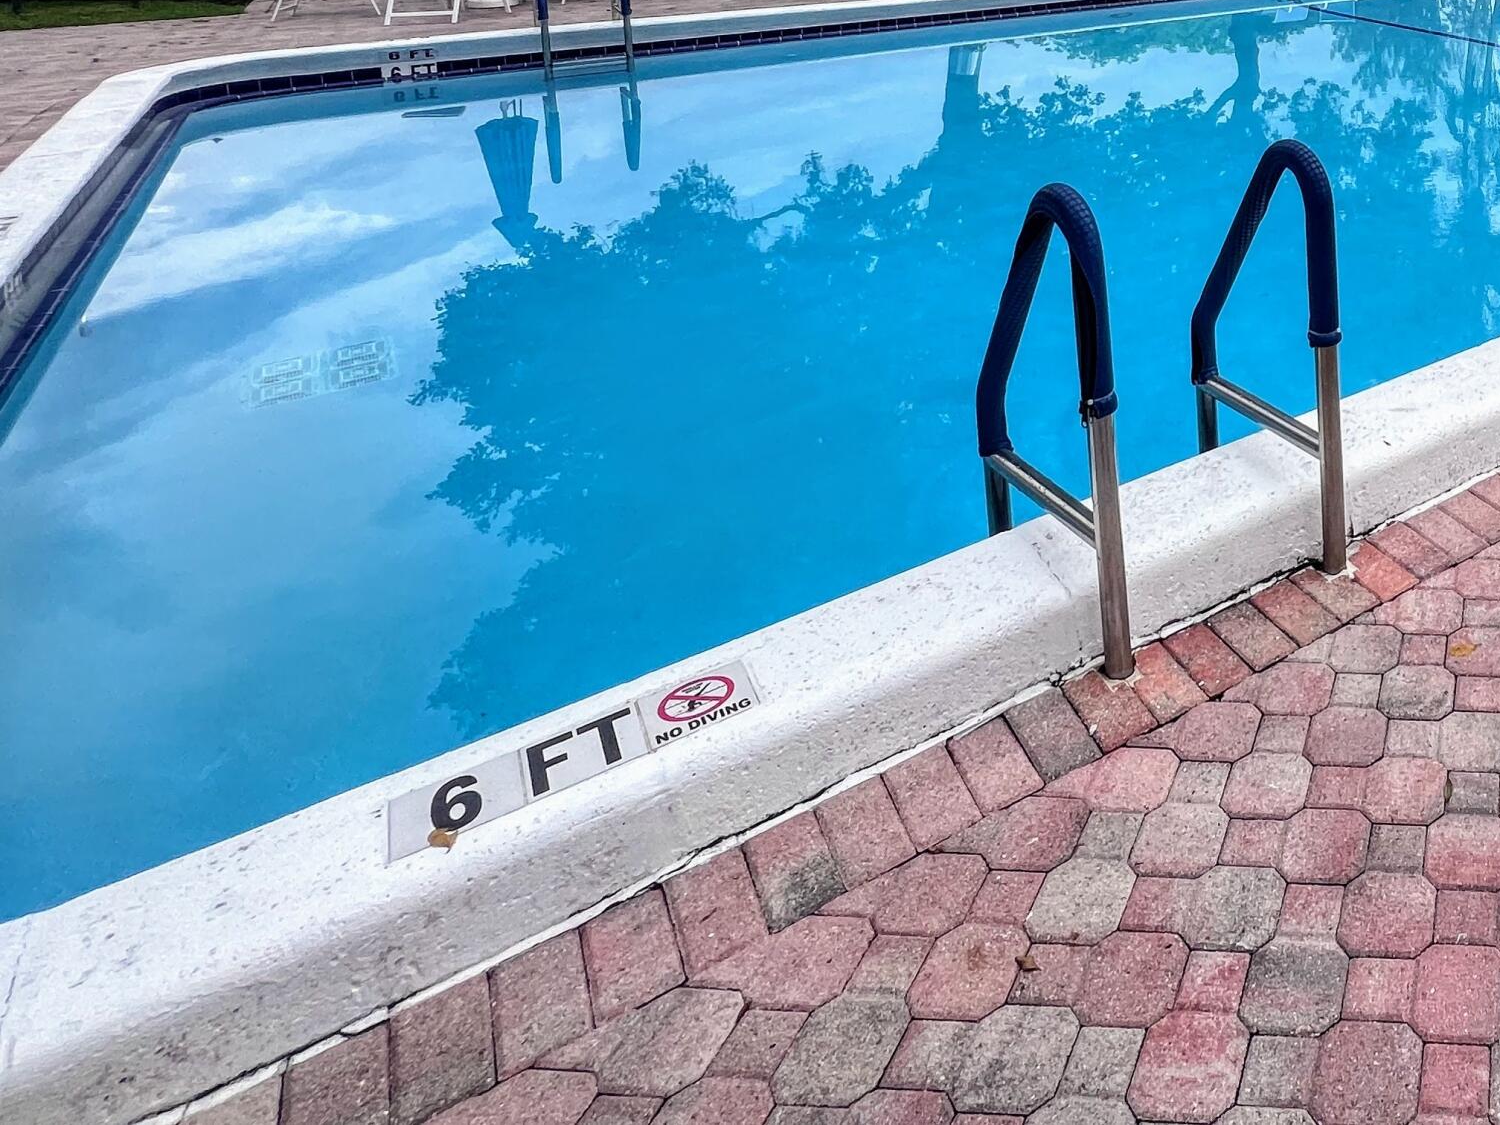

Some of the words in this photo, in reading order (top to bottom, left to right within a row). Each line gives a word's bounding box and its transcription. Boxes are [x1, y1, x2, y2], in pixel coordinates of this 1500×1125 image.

[655, 727, 683, 745] NO
[688, 698, 752, 730] DIVING
[430, 774, 483, 832] 6
[525, 707, 631, 797] FT
